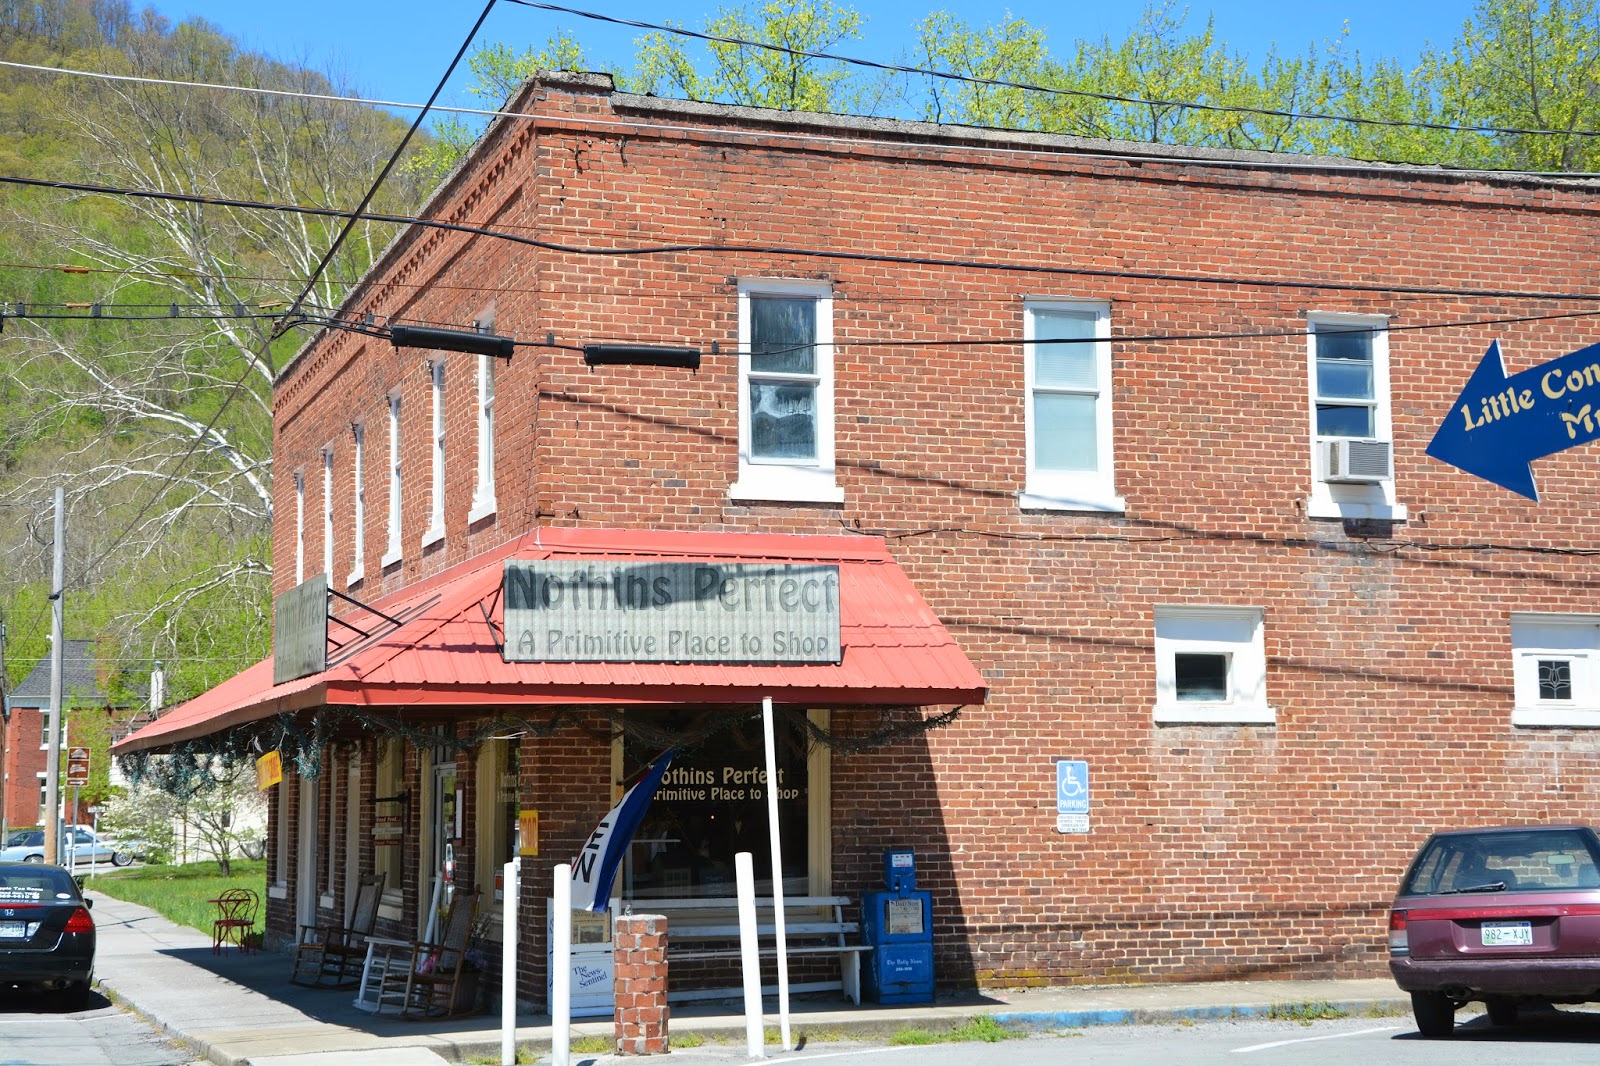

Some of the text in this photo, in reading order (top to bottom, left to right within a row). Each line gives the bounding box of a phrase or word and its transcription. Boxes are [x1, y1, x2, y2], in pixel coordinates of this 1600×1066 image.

[1460, 386, 1535, 432] Little
[508, 564, 838, 613] Nothins Perfect
[518, 629, 829, 657] A Primitive Place to Shop
[660, 766, 785, 785] othins Perfet
[655, 787, 799, 801] rimitive Place to hop
[1060, 799, 1087, 808] PARKING
[1485, 929, 1529, 939] 982-XJY
[571, 965, 587, 975] The
[579, 971, 608, 989] Sentinel
